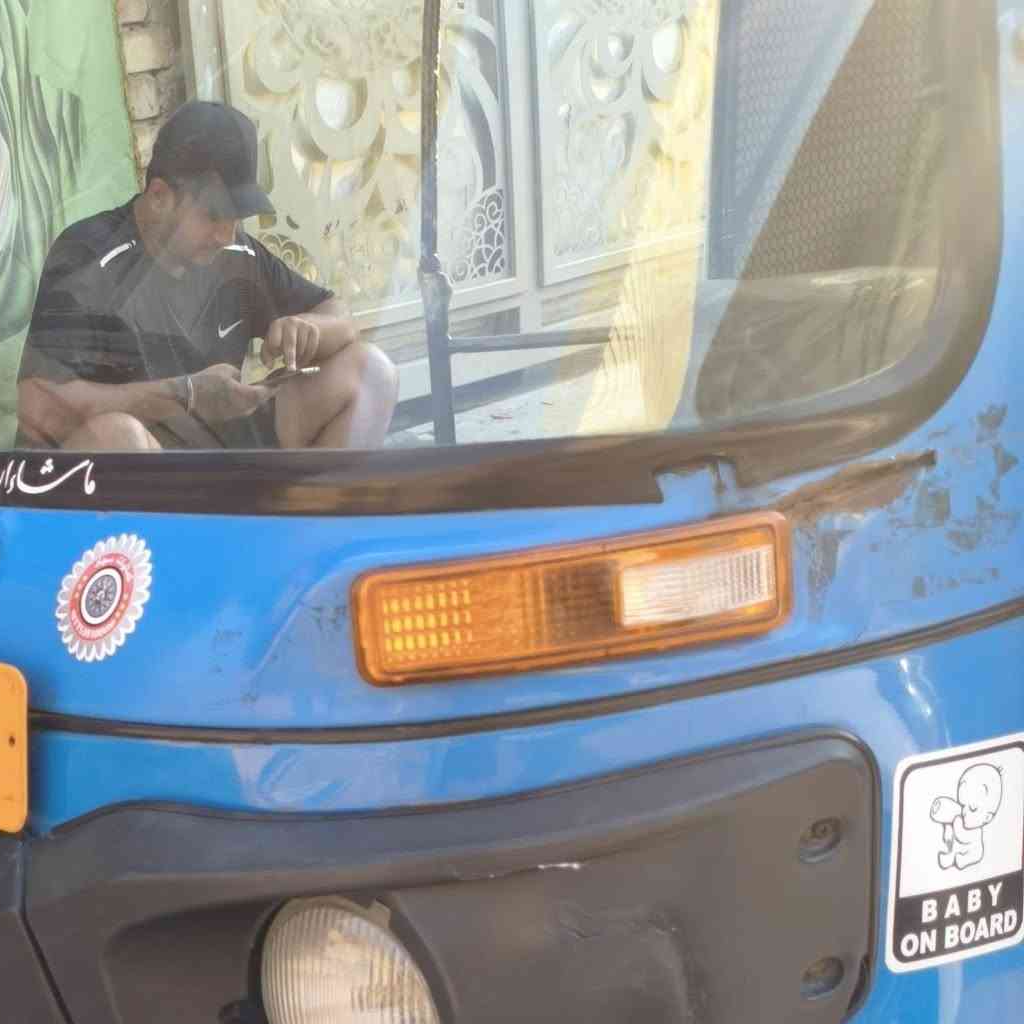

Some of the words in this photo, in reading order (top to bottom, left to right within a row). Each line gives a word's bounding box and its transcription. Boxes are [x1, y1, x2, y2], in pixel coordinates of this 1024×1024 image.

[921, 882, 1003, 923] BABY
[900, 929, 937, 957] ON
[944, 909, 1018, 949] BOARD
